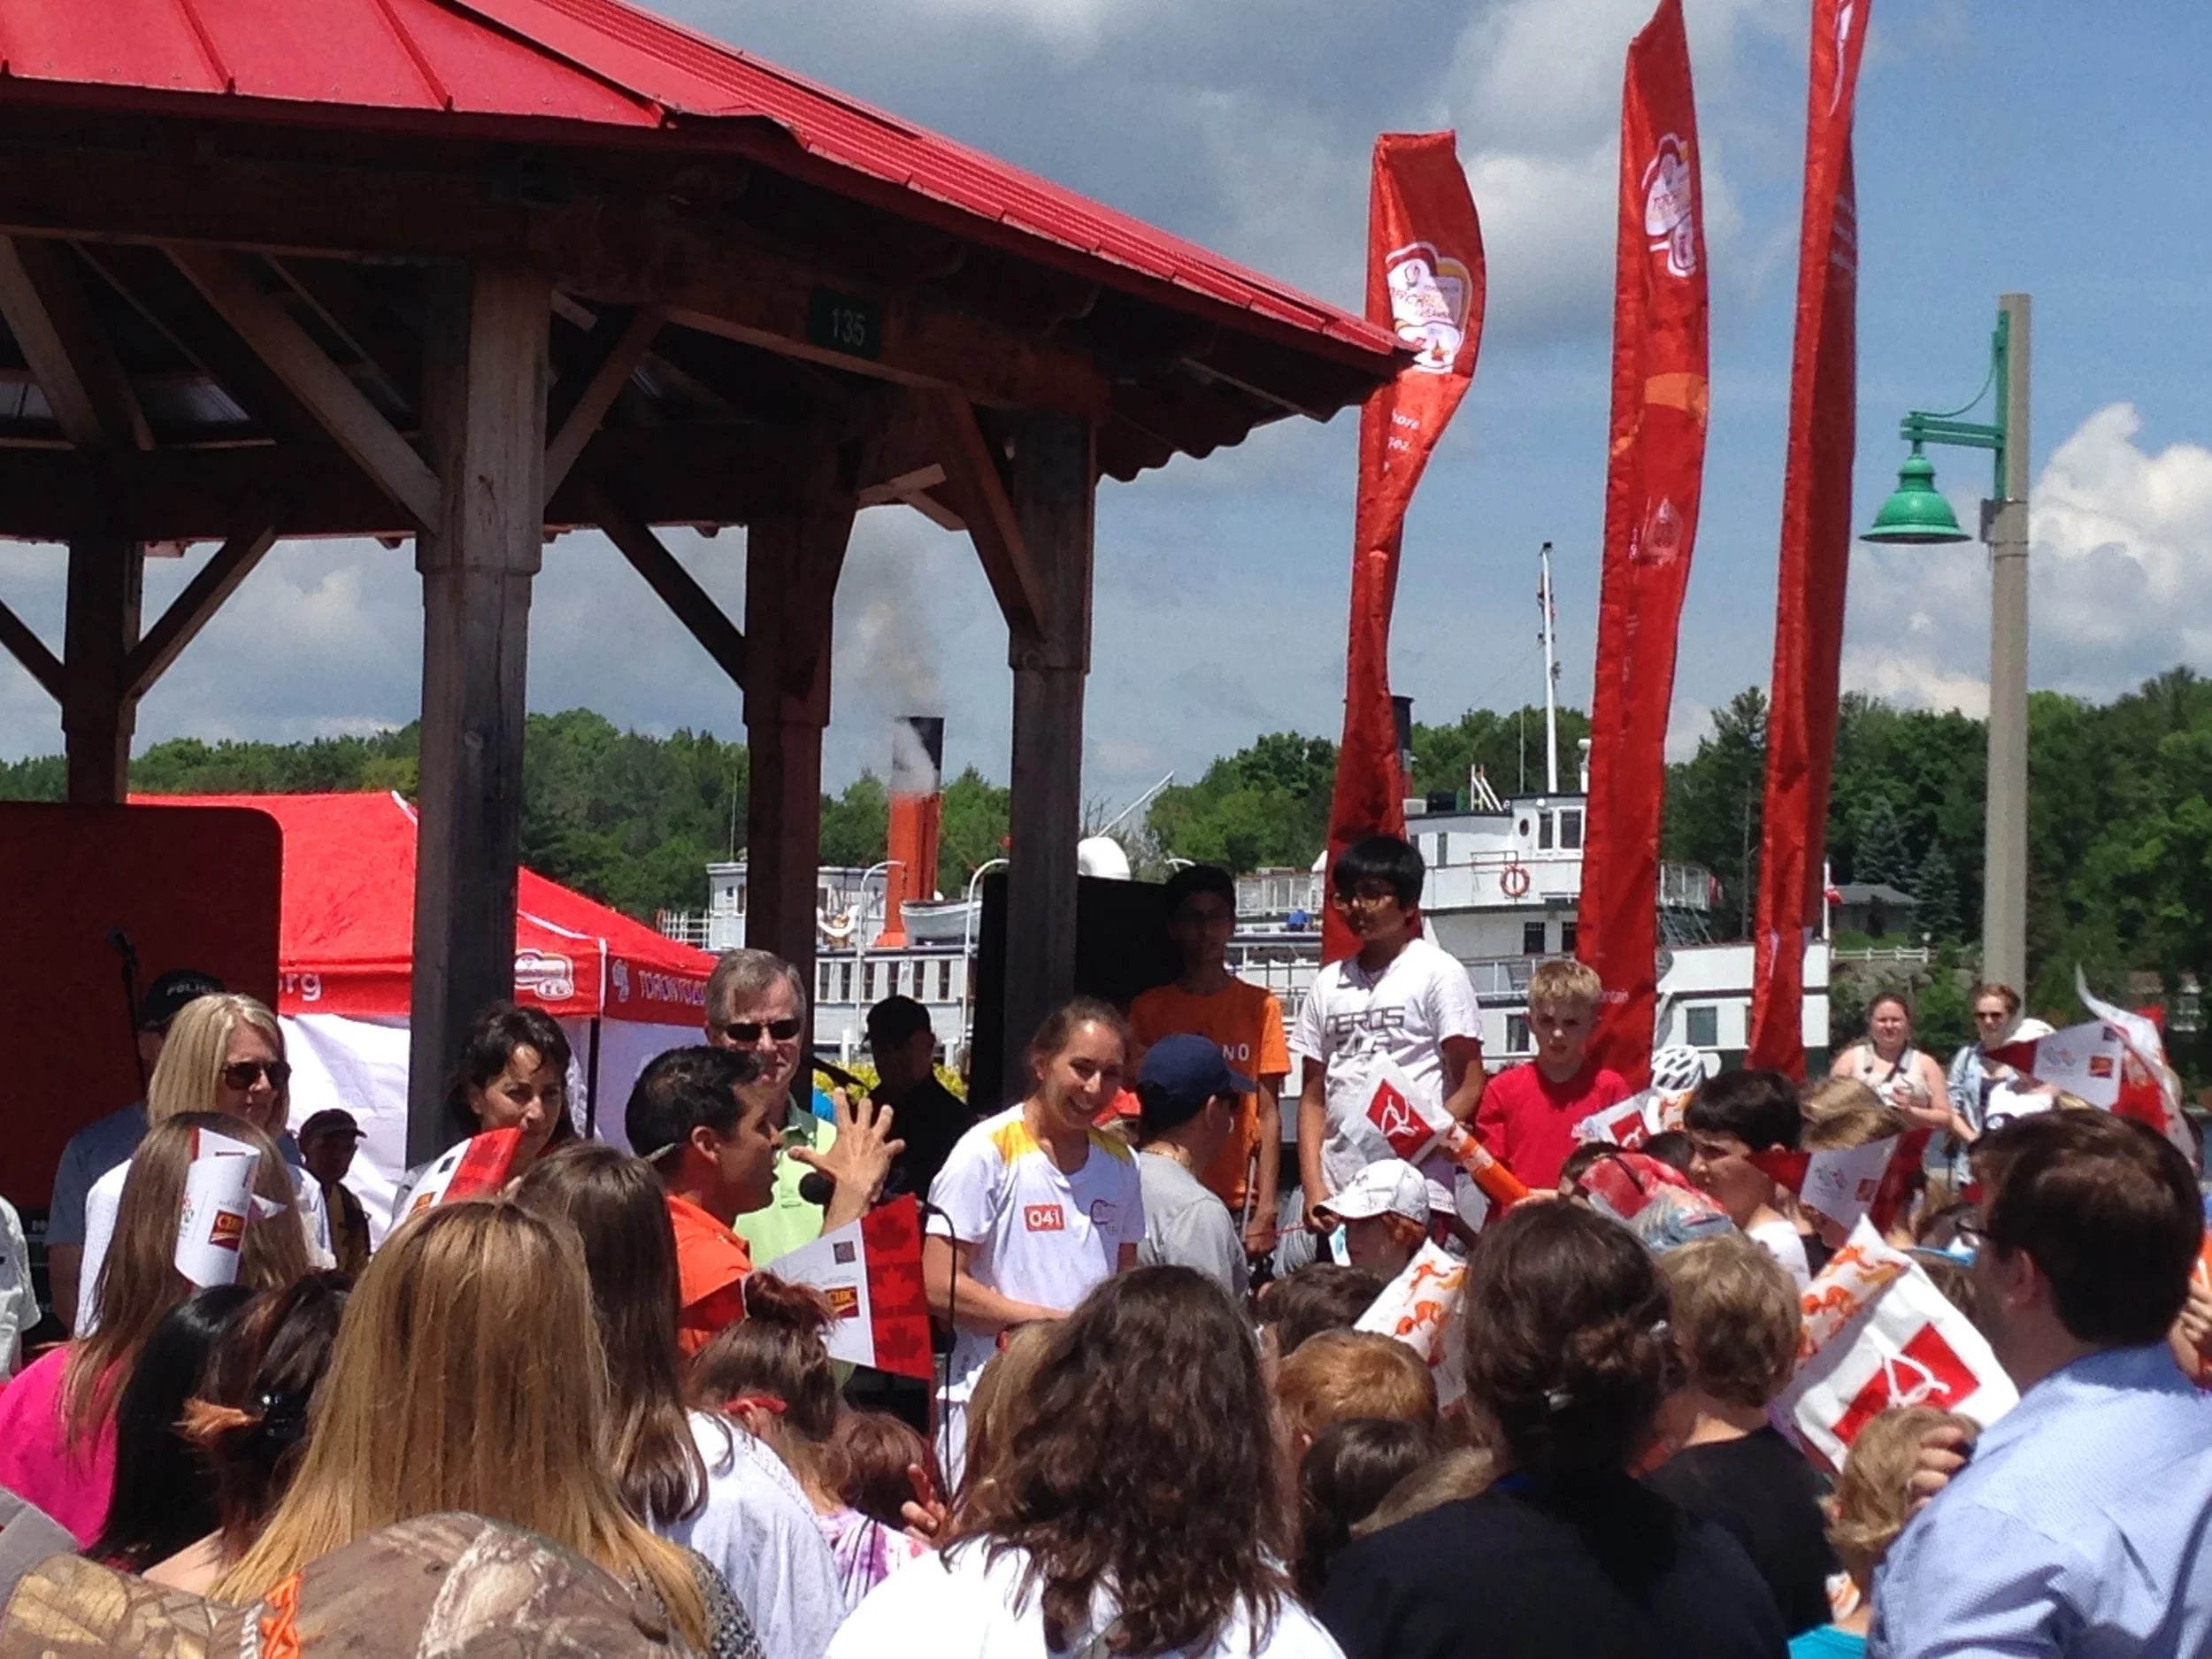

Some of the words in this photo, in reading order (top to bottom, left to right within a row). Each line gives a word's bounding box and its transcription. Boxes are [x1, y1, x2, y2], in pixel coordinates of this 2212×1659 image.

[832, 307, 865, 348] 135
[279, 973, 321, 1001] rg
[1029, 1210, 1062, 1227] 041
